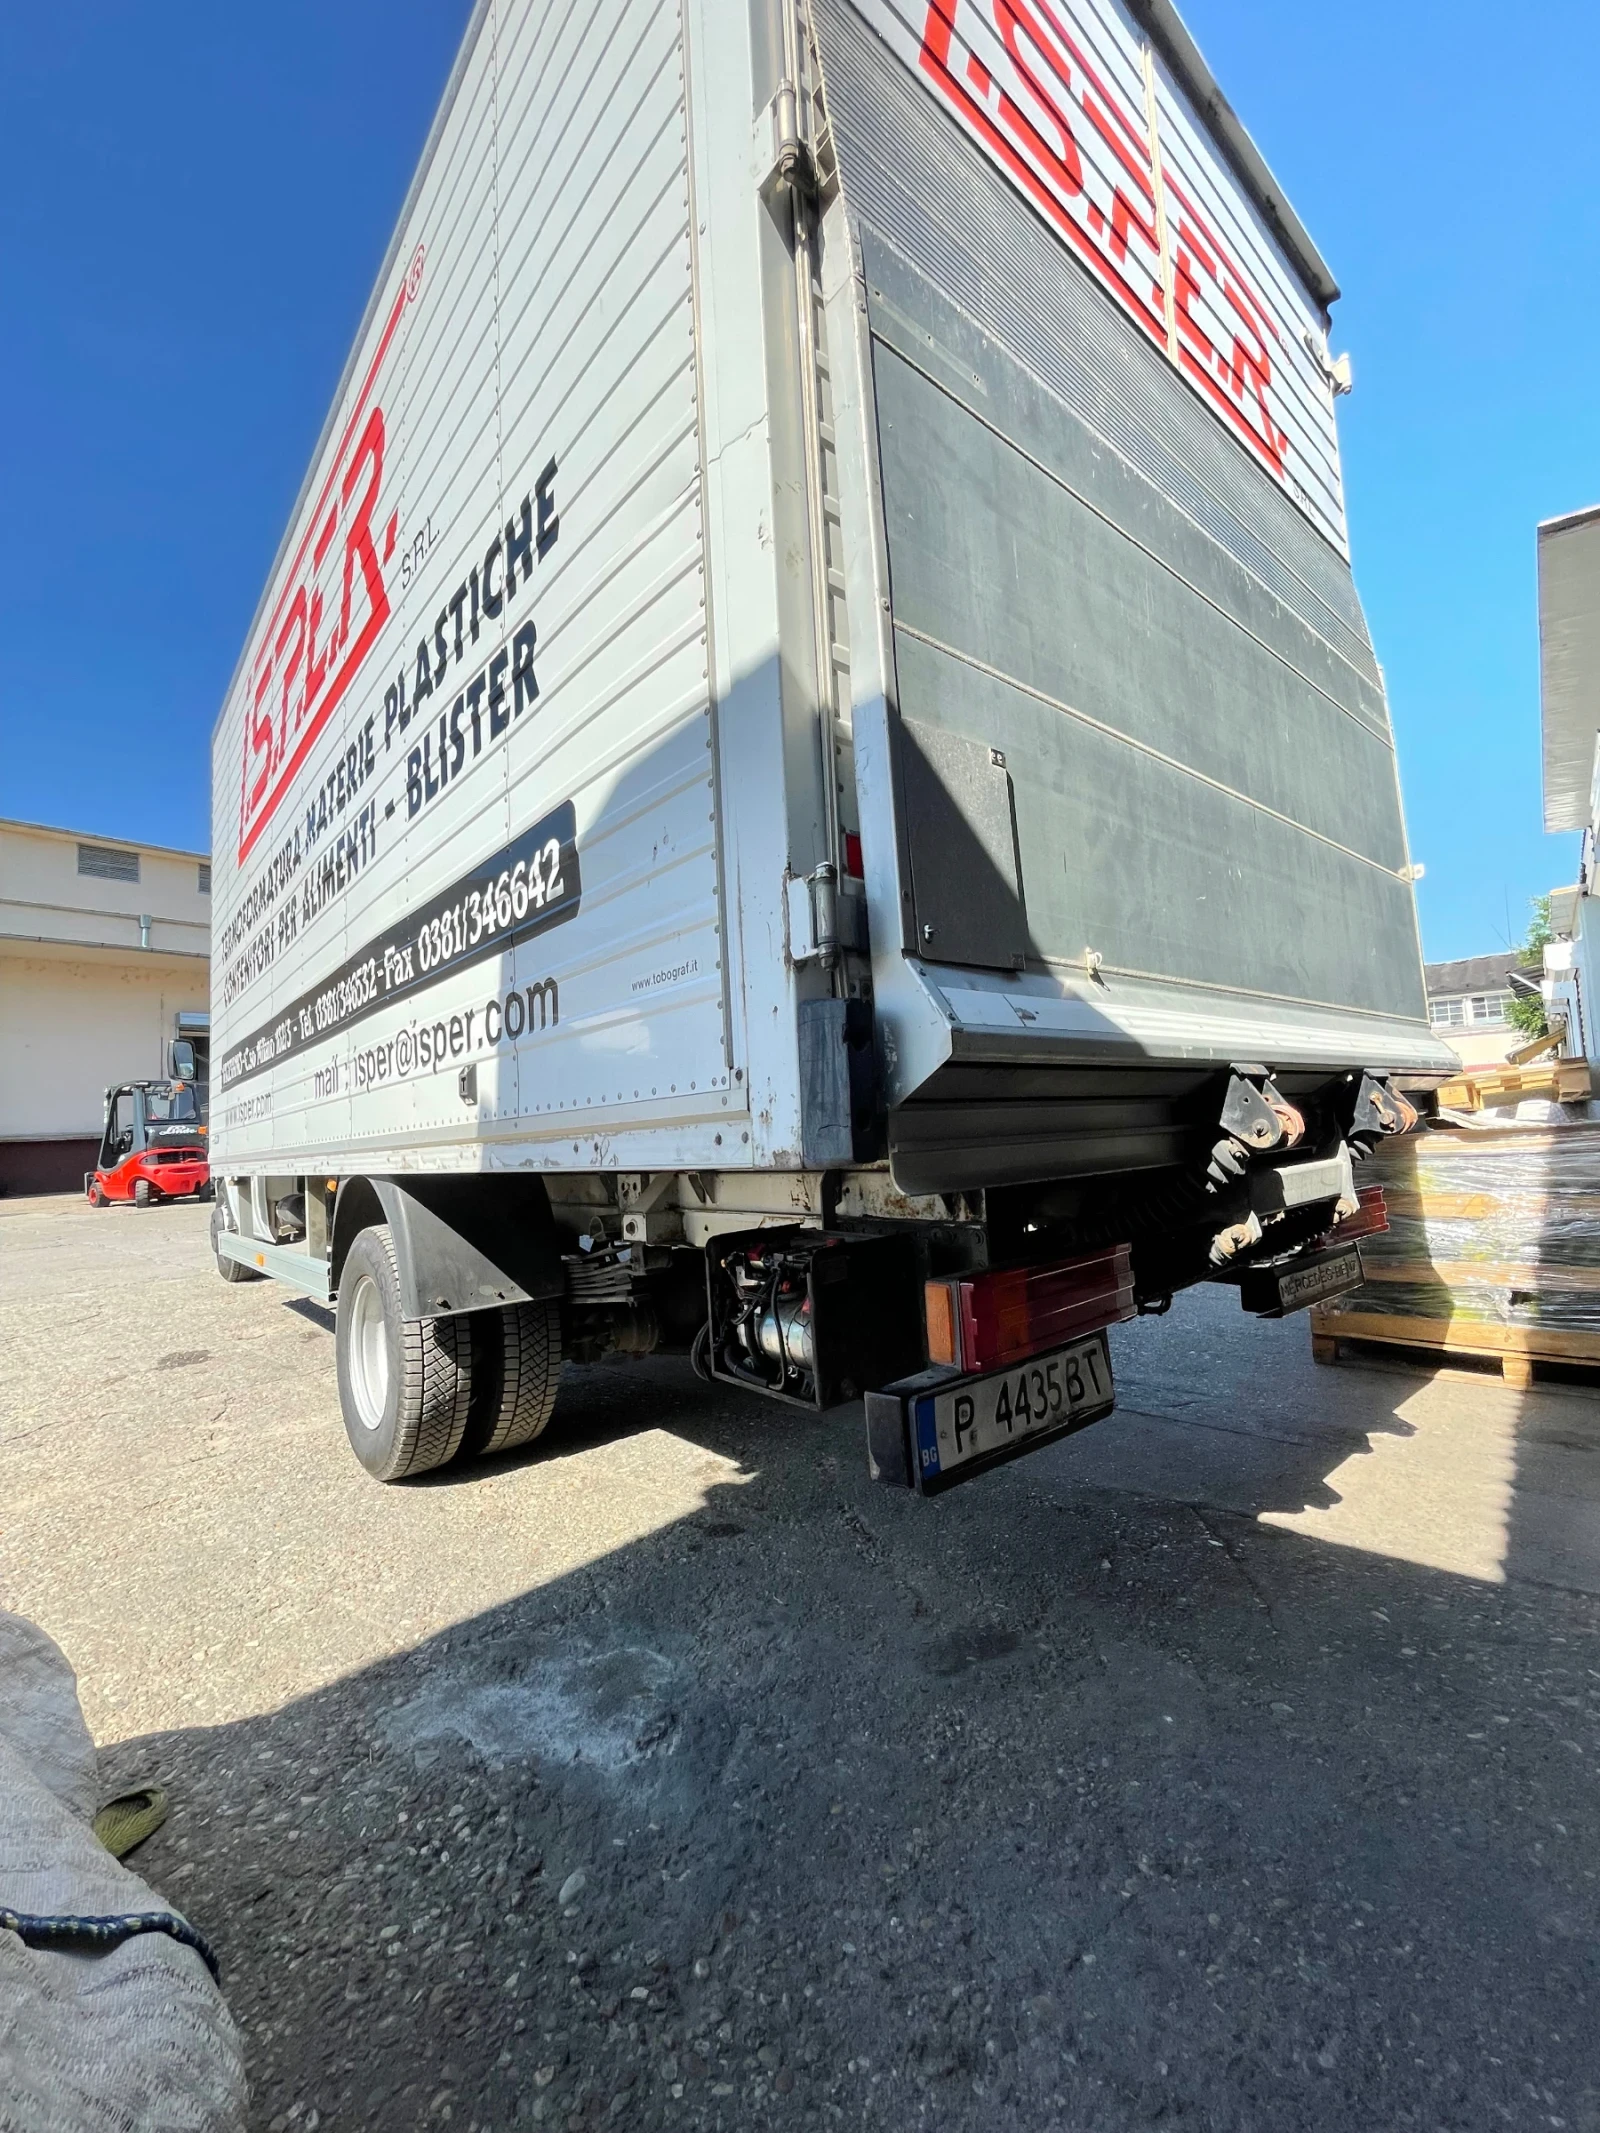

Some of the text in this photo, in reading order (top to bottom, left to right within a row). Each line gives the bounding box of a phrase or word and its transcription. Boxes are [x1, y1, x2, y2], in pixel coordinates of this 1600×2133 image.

[401, 516, 440, 590] S.R.L.
[305, 711, 375, 855] MATERIE
[384, 453, 560, 753] PLASTICHE
[278, 894, 297, 955] PER
[302, 797, 375, 928] ALIMENTI
[406, 619, 540, 822] BLISTER
[299, 1004, 315, 1040] Tel.
[418, 838, 565, 972] 0381/346642
[631, 959, 698, 992] www.tobograf.it
[313, 1054, 339, 1099] mail
[353, 976, 559, 1093] isper@isper.com
[159, 1125, 197, 1136] Linde
[922, 1446, 938, 1468] BG
[954, 1394, 975, 1454] P
